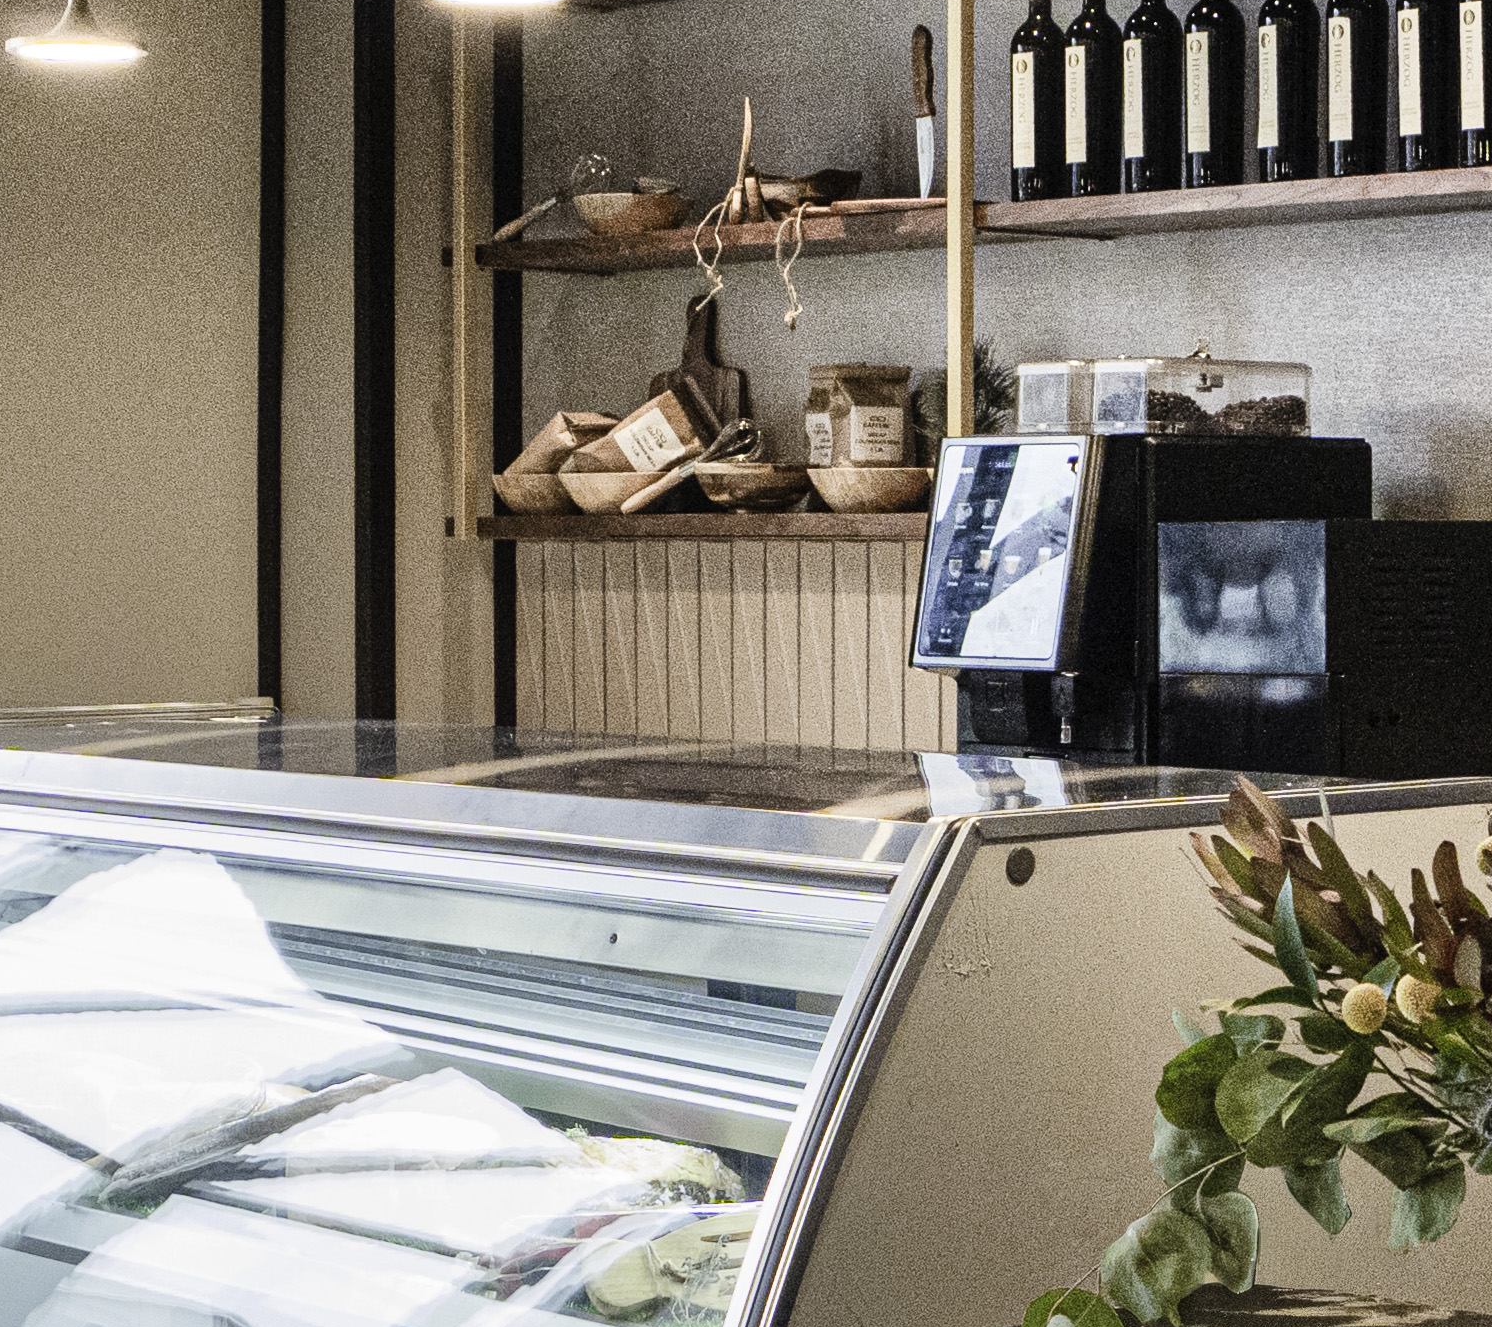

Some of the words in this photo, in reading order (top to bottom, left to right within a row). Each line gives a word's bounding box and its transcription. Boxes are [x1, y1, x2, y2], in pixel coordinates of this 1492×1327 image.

[1261, 50, 1269, 102] HERZOG
[1333, 42, 1343, 94] HERZOG
[1402, 37, 1412, 89] HERZOG
[1465, 28, 1475, 81] HERZOG
[1070, 71, 1080, 119] HERZOG
[1191, 58, 1201, 106] HERZOG
